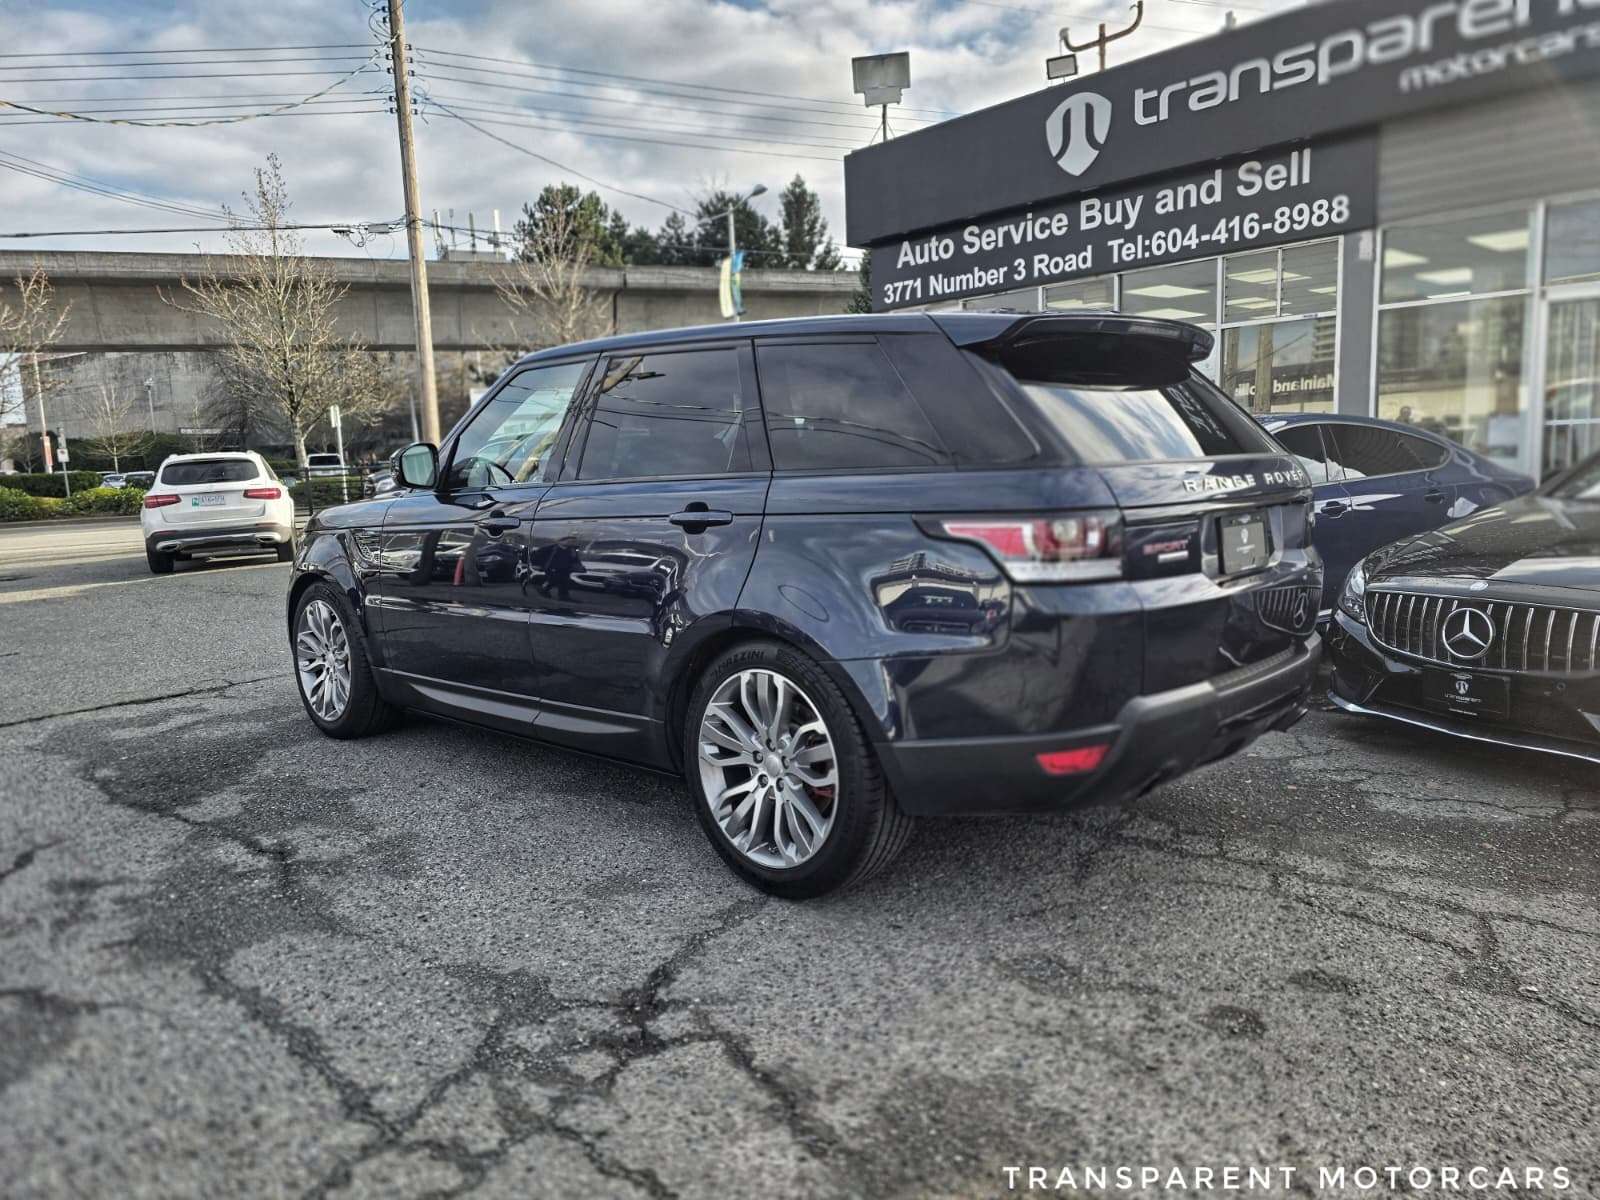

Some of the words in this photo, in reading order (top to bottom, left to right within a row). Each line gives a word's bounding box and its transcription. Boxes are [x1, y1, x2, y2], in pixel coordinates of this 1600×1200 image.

[884, 278, 922, 304] 3771
[929, 266, 1008, 296] Number
[1013, 258, 1026, 280] 3
[1033, 244, 1093, 278] Road
[1107, 194, 1350, 264] Tel:604-416-8988
[897, 235, 954, 269] Auto
[962, 212, 1069, 254] Service
[1080, 195, 1144, 230] Buy
[1155, 168, 1222, 215] and
[1237, 148, 1311, 197] Sell
[1183, 474, 1256, 493] RANGE
[1263, 470, 1304, 485] ROVER
